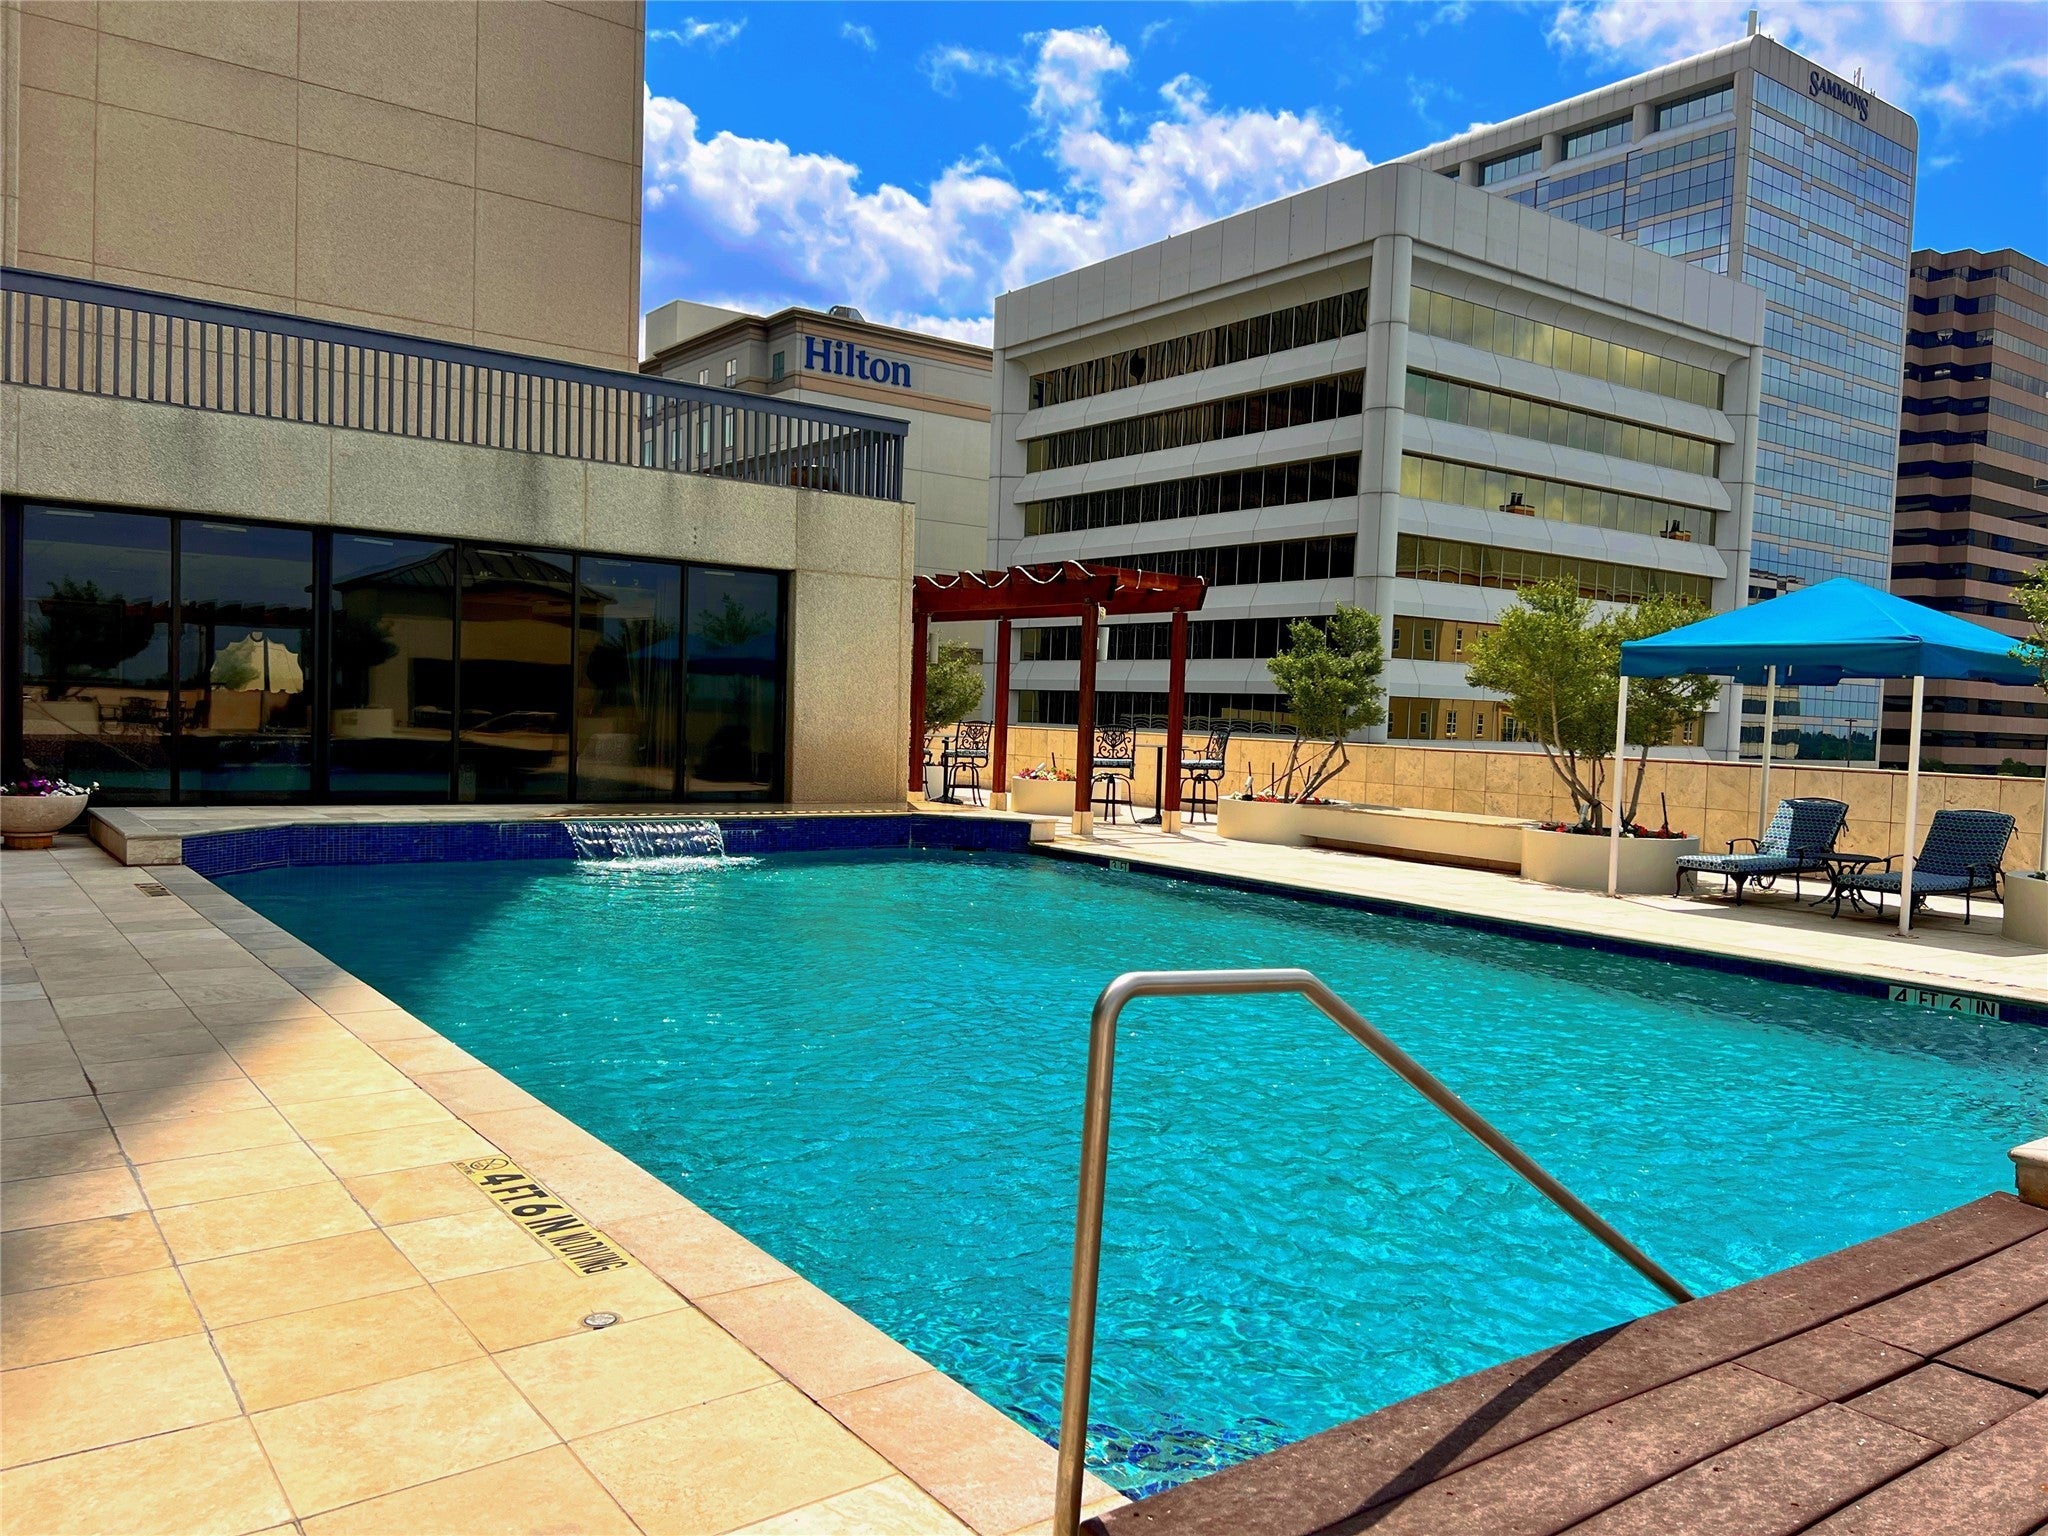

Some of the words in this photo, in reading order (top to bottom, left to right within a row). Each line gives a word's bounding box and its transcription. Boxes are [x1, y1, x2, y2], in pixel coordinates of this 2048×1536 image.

[1809, 71, 1869, 122] SAMMONS
[804, 336, 912, 388] Hilton
[1894, 988, 1907, 1002] 4
[1919, 991, 1939, 1007] FT
[1975, 999, 1996, 1017] IN
[480, 1173, 526, 1186] 4
[490, 1183, 549, 1205] FT.
[511, 1203, 564, 1217] 6
[524, 1214, 584, 1238] IN.
[547, 1231, 598, 1247] NO
[558, 1241, 629, 1275] DIVING
